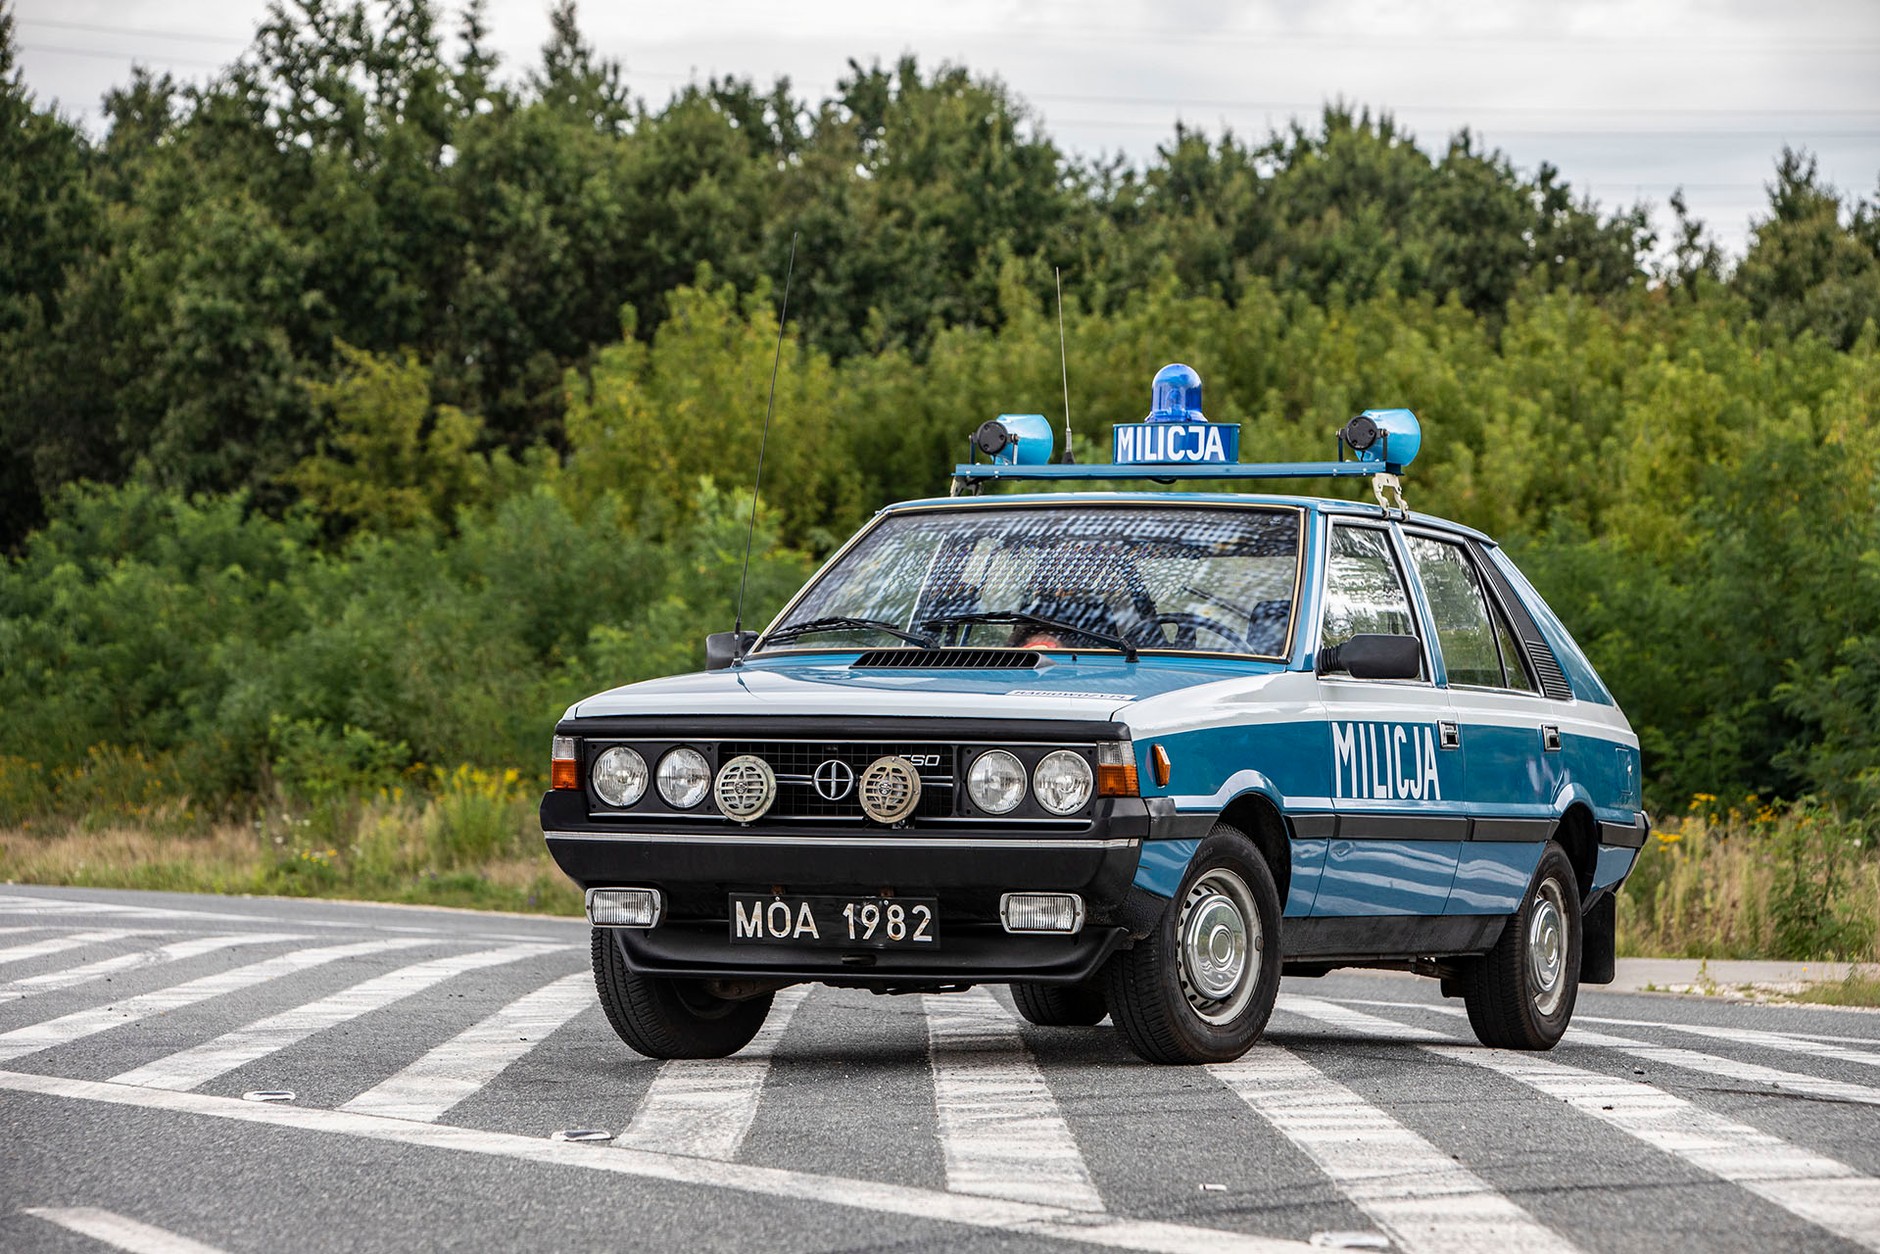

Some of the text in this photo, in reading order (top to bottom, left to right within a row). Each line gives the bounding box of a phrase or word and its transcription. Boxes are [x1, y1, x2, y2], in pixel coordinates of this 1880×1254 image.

[1117, 425, 1226, 463] MILICJA
[1331, 721, 1441, 801] MILICJA
[735, 900, 933, 943] MOA 1982
